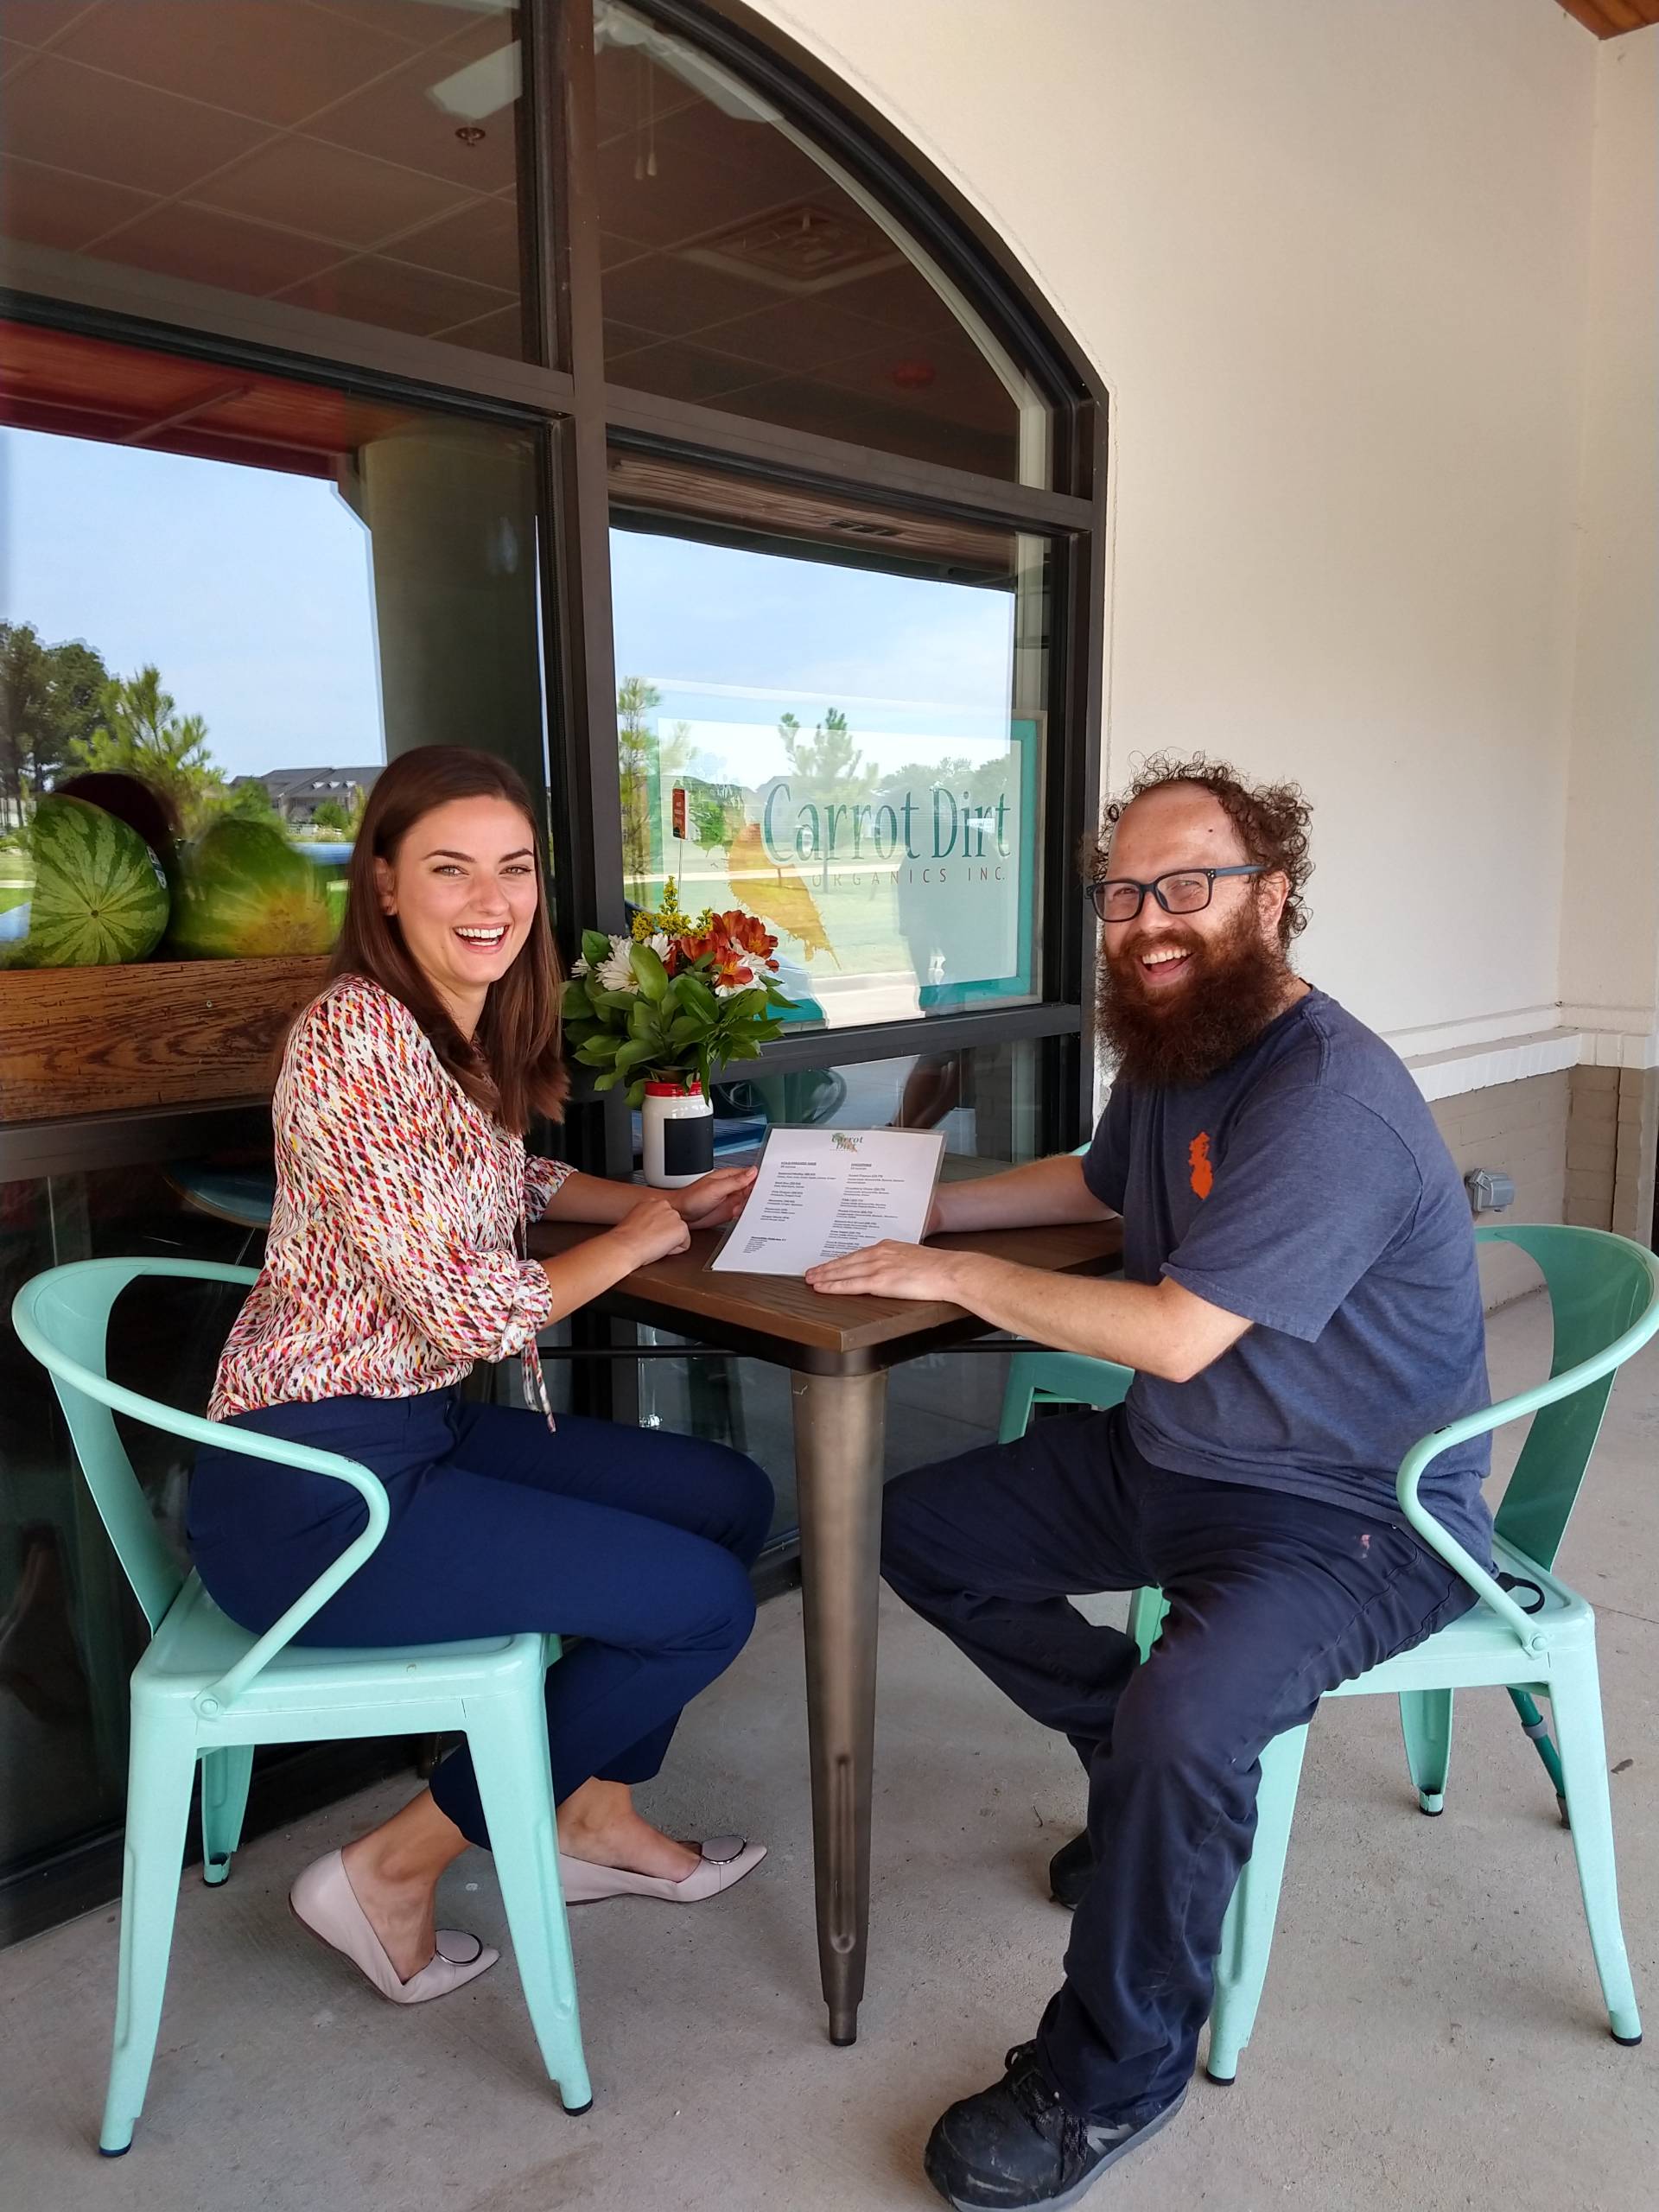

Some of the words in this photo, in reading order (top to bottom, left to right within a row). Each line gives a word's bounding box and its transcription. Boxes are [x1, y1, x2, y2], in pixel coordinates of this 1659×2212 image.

[764, 784, 920, 861] Carrot
[930, 786, 1011, 858] Dirt
[812, 868, 947, 887] ORGANICS
[968, 866, 1006, 881] INC.
